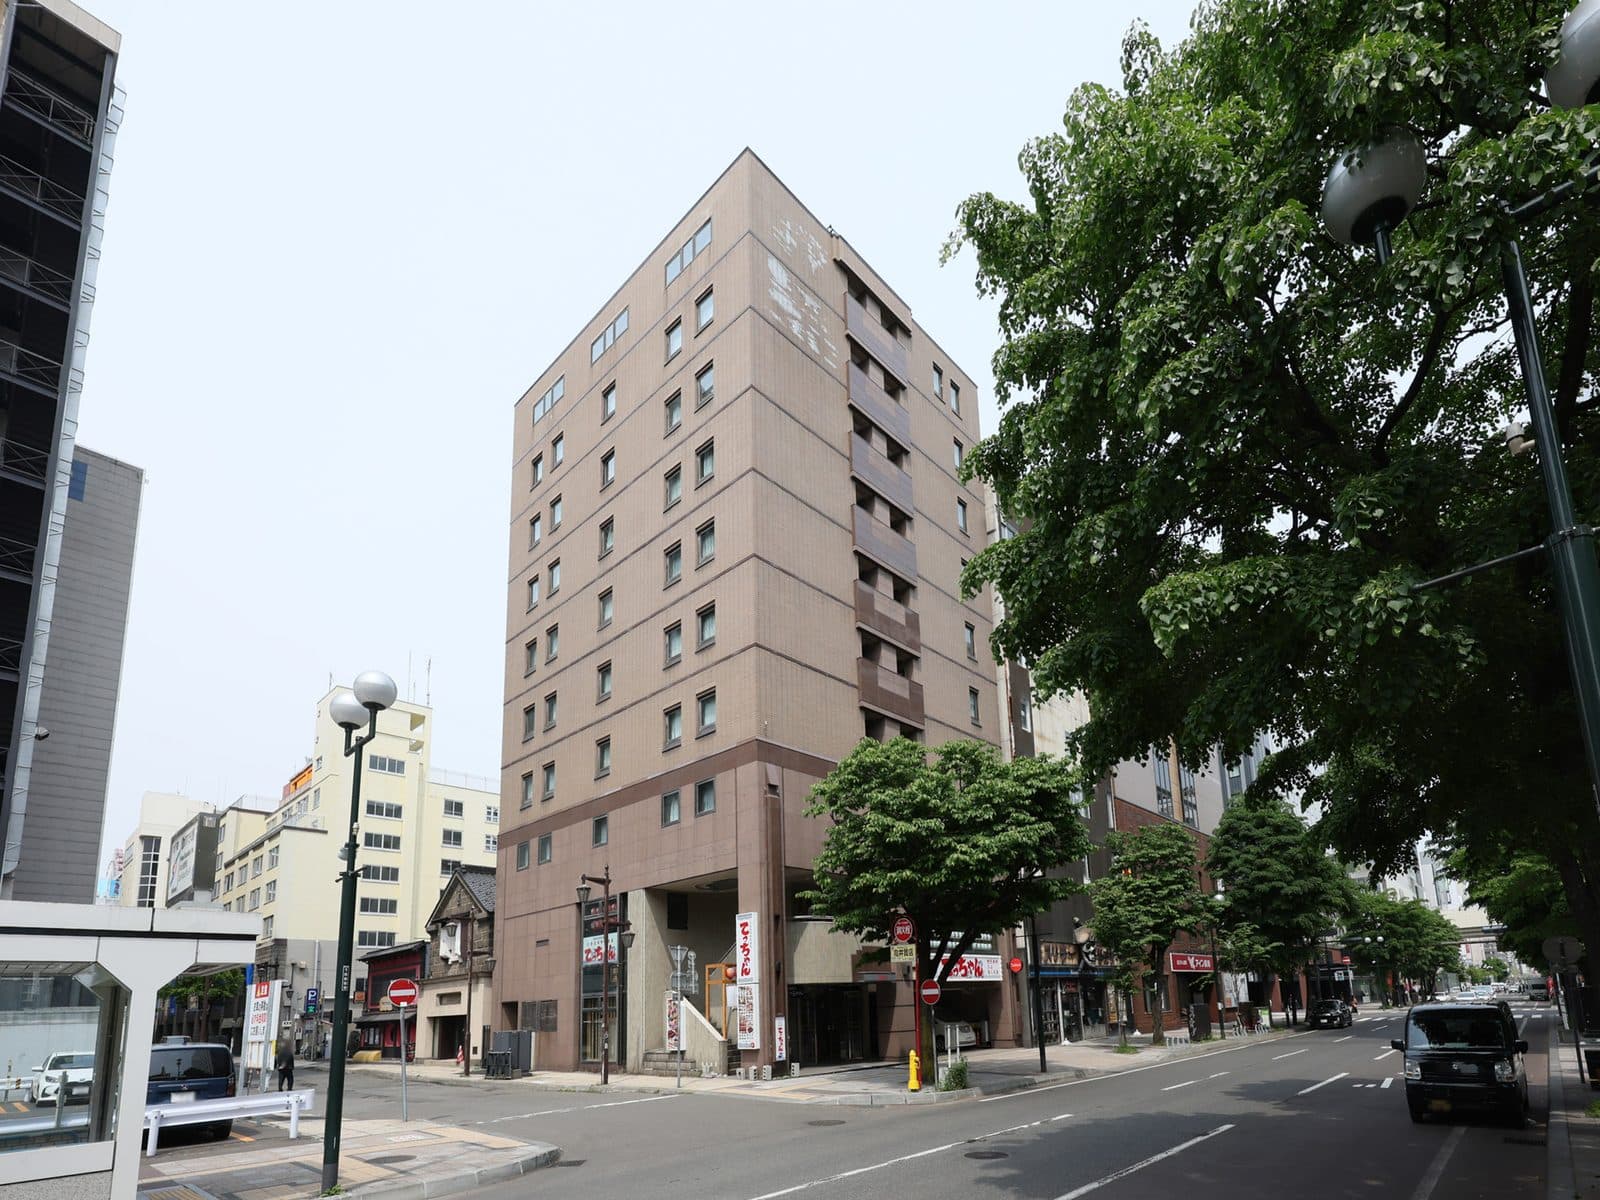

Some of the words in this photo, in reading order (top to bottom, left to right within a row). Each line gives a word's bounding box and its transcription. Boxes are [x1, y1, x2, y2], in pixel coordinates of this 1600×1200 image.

[584, 945, 616, 962] てっちん
[740, 921, 751, 976] てっちゃん
[308, 990, 317, 1001] P
